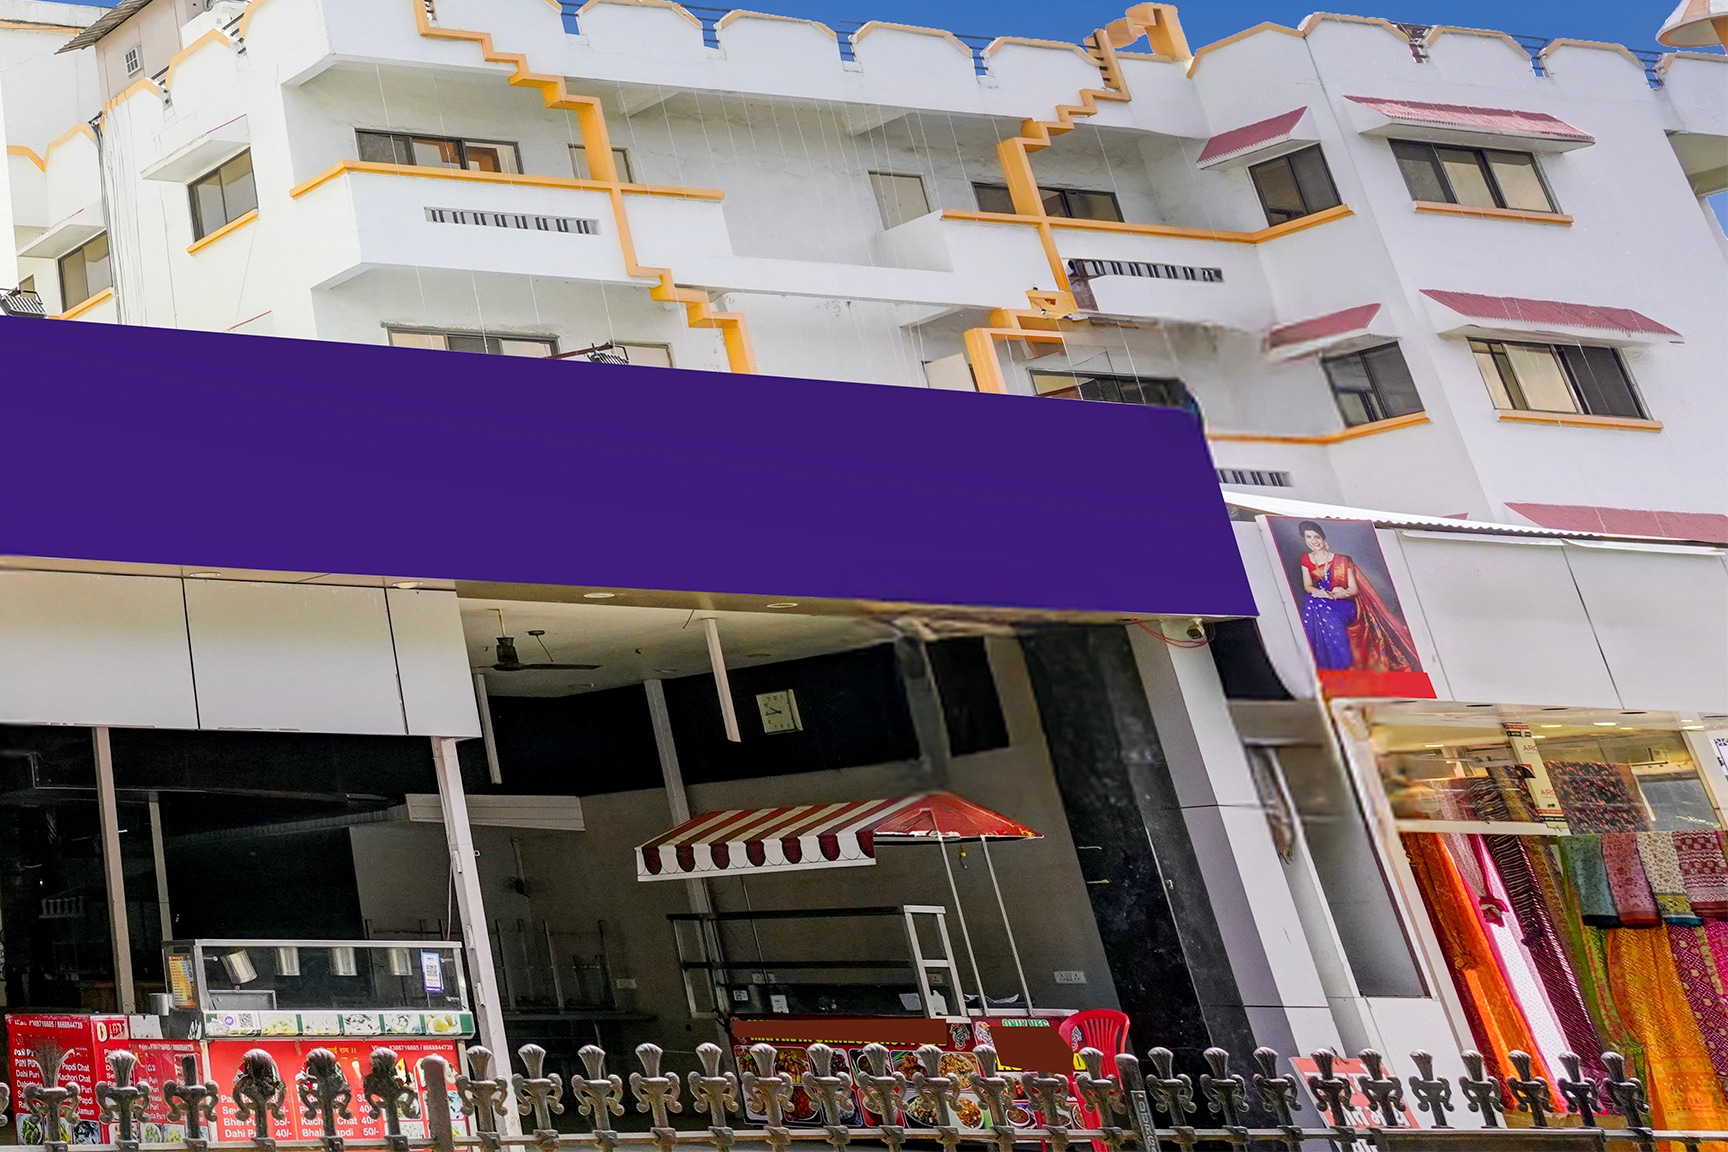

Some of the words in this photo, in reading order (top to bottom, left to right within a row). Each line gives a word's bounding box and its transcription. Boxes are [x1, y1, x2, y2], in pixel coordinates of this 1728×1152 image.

[15, 1070, 28, 1078] Dahi
[225, 1129, 246, 1137] Dahi
[276, 1129, 292, 1137] 40/-
[363, 1128, 379, 1136] 50/-
